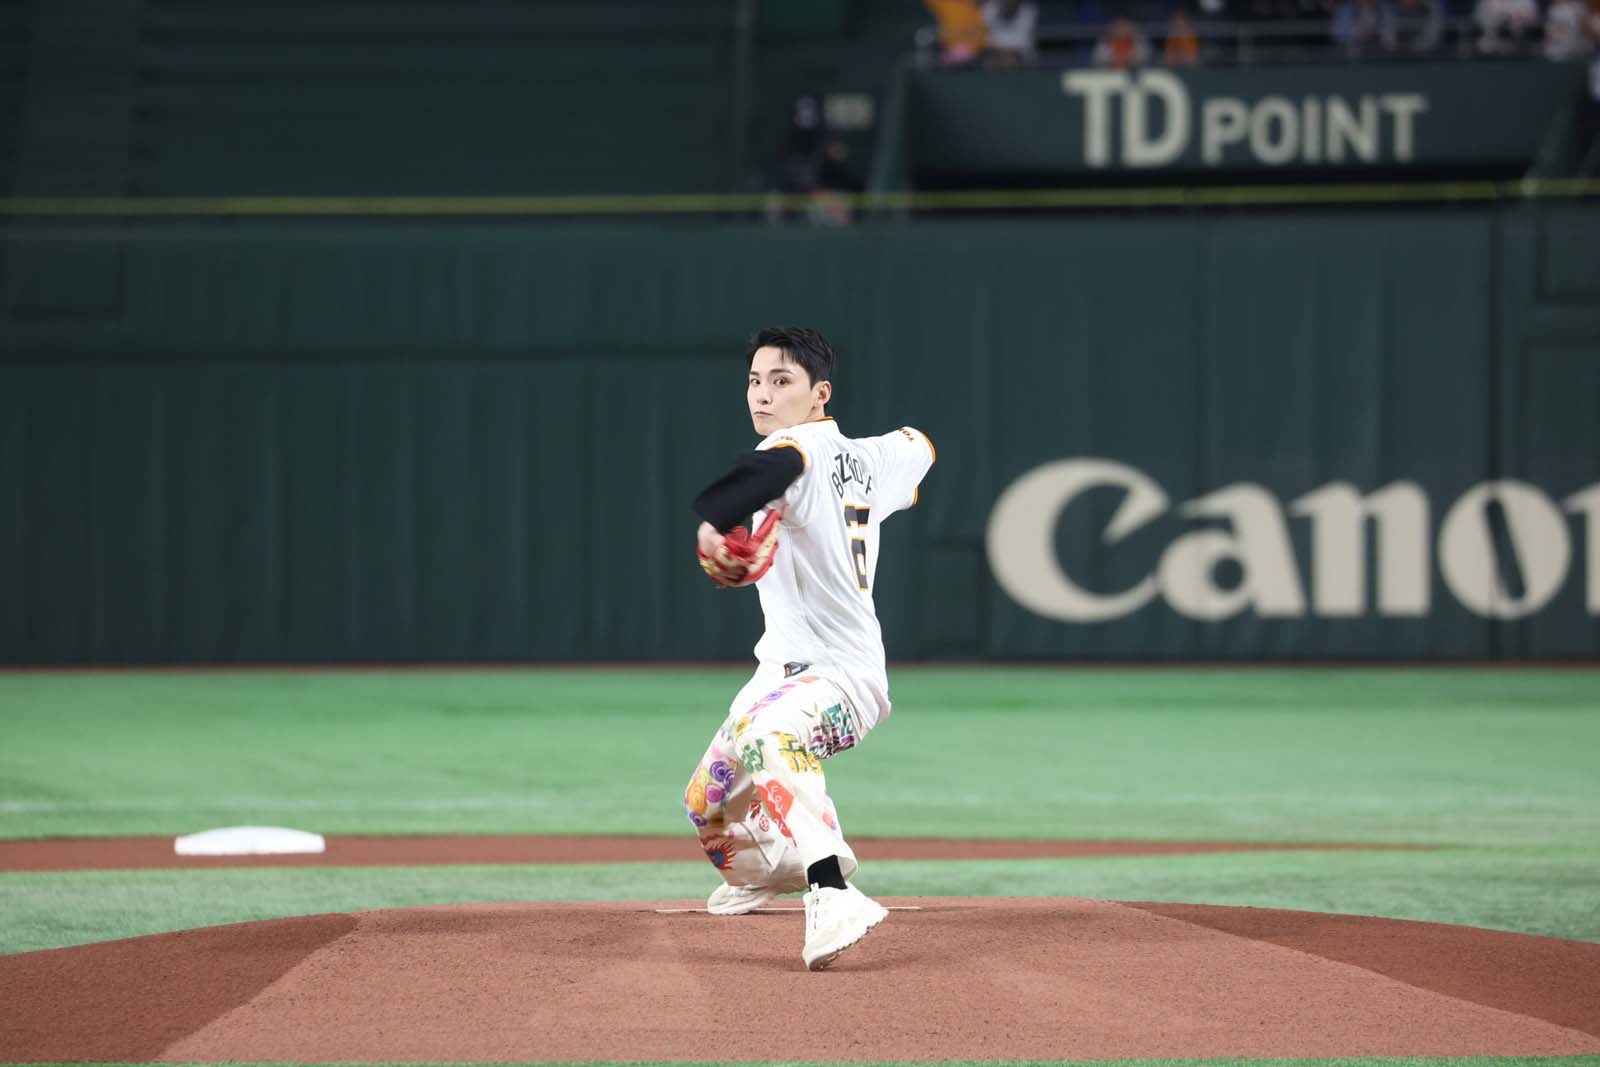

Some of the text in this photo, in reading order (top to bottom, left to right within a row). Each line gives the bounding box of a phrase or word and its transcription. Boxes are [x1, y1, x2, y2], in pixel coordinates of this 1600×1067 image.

[1062, 69, 1426, 167] TD POINT
[986, 457, 1600, 622] Cano
